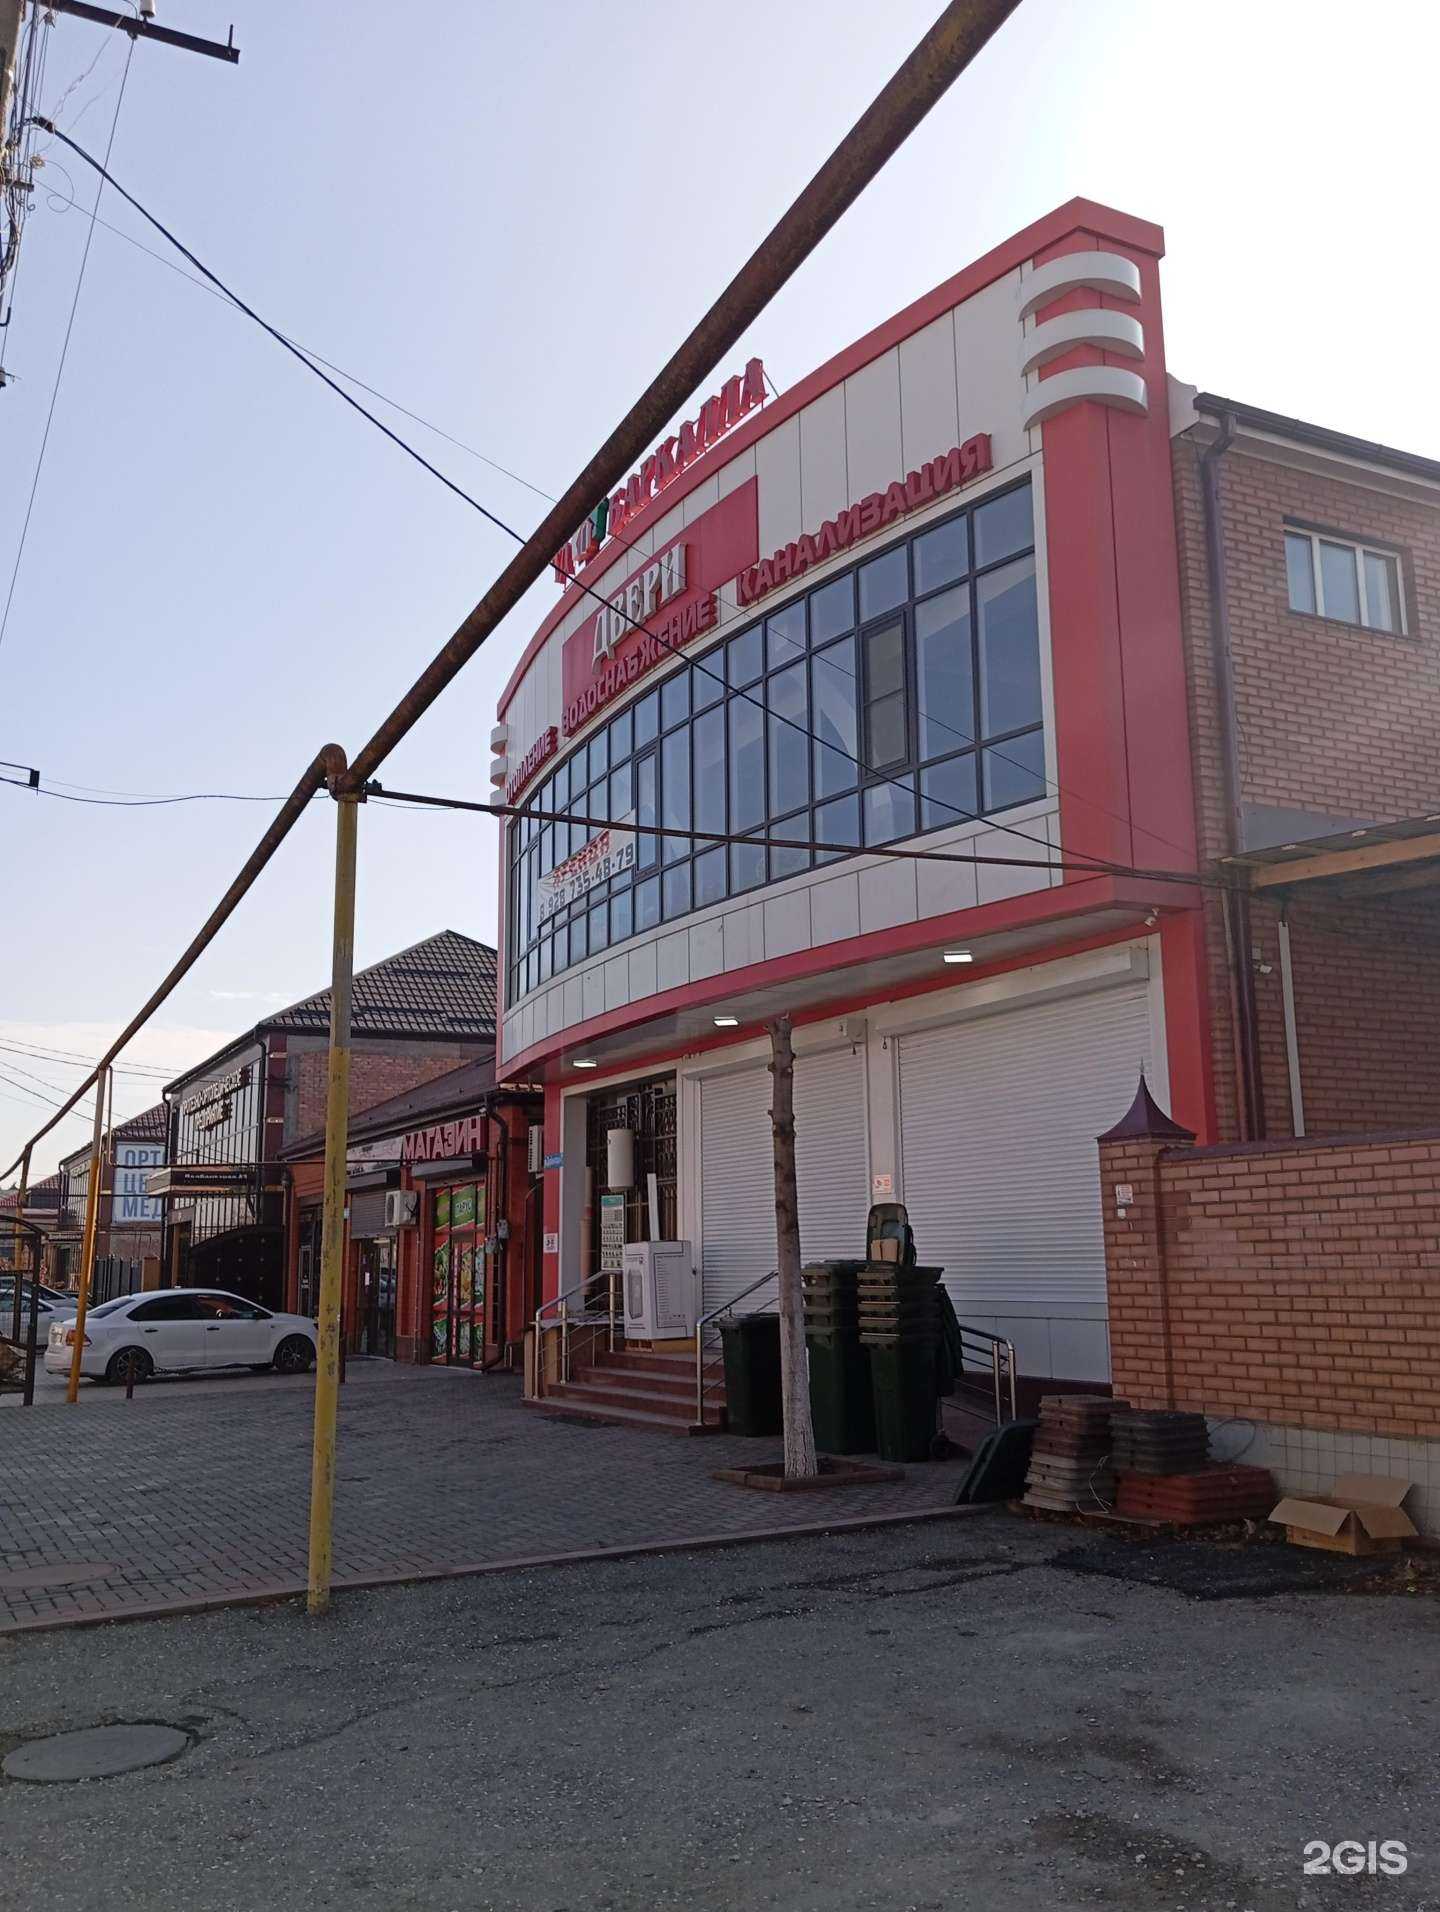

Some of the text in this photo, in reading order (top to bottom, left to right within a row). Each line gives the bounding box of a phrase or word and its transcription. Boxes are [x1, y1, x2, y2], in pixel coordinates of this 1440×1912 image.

[737, 433, 993, 606] КАНАЛИЗАЦИЯ
[592, 541, 687, 674] ДВЕРИ
[562, 594, 717, 737] ВОДОСНАБЖЕНИЕ
[506, 727, 558, 805] ОТОПЛЕНИЕ
[125, 1150, 165, 1166] ОРТ
[403, 1115, 481, 1159] МАГАЗИН
